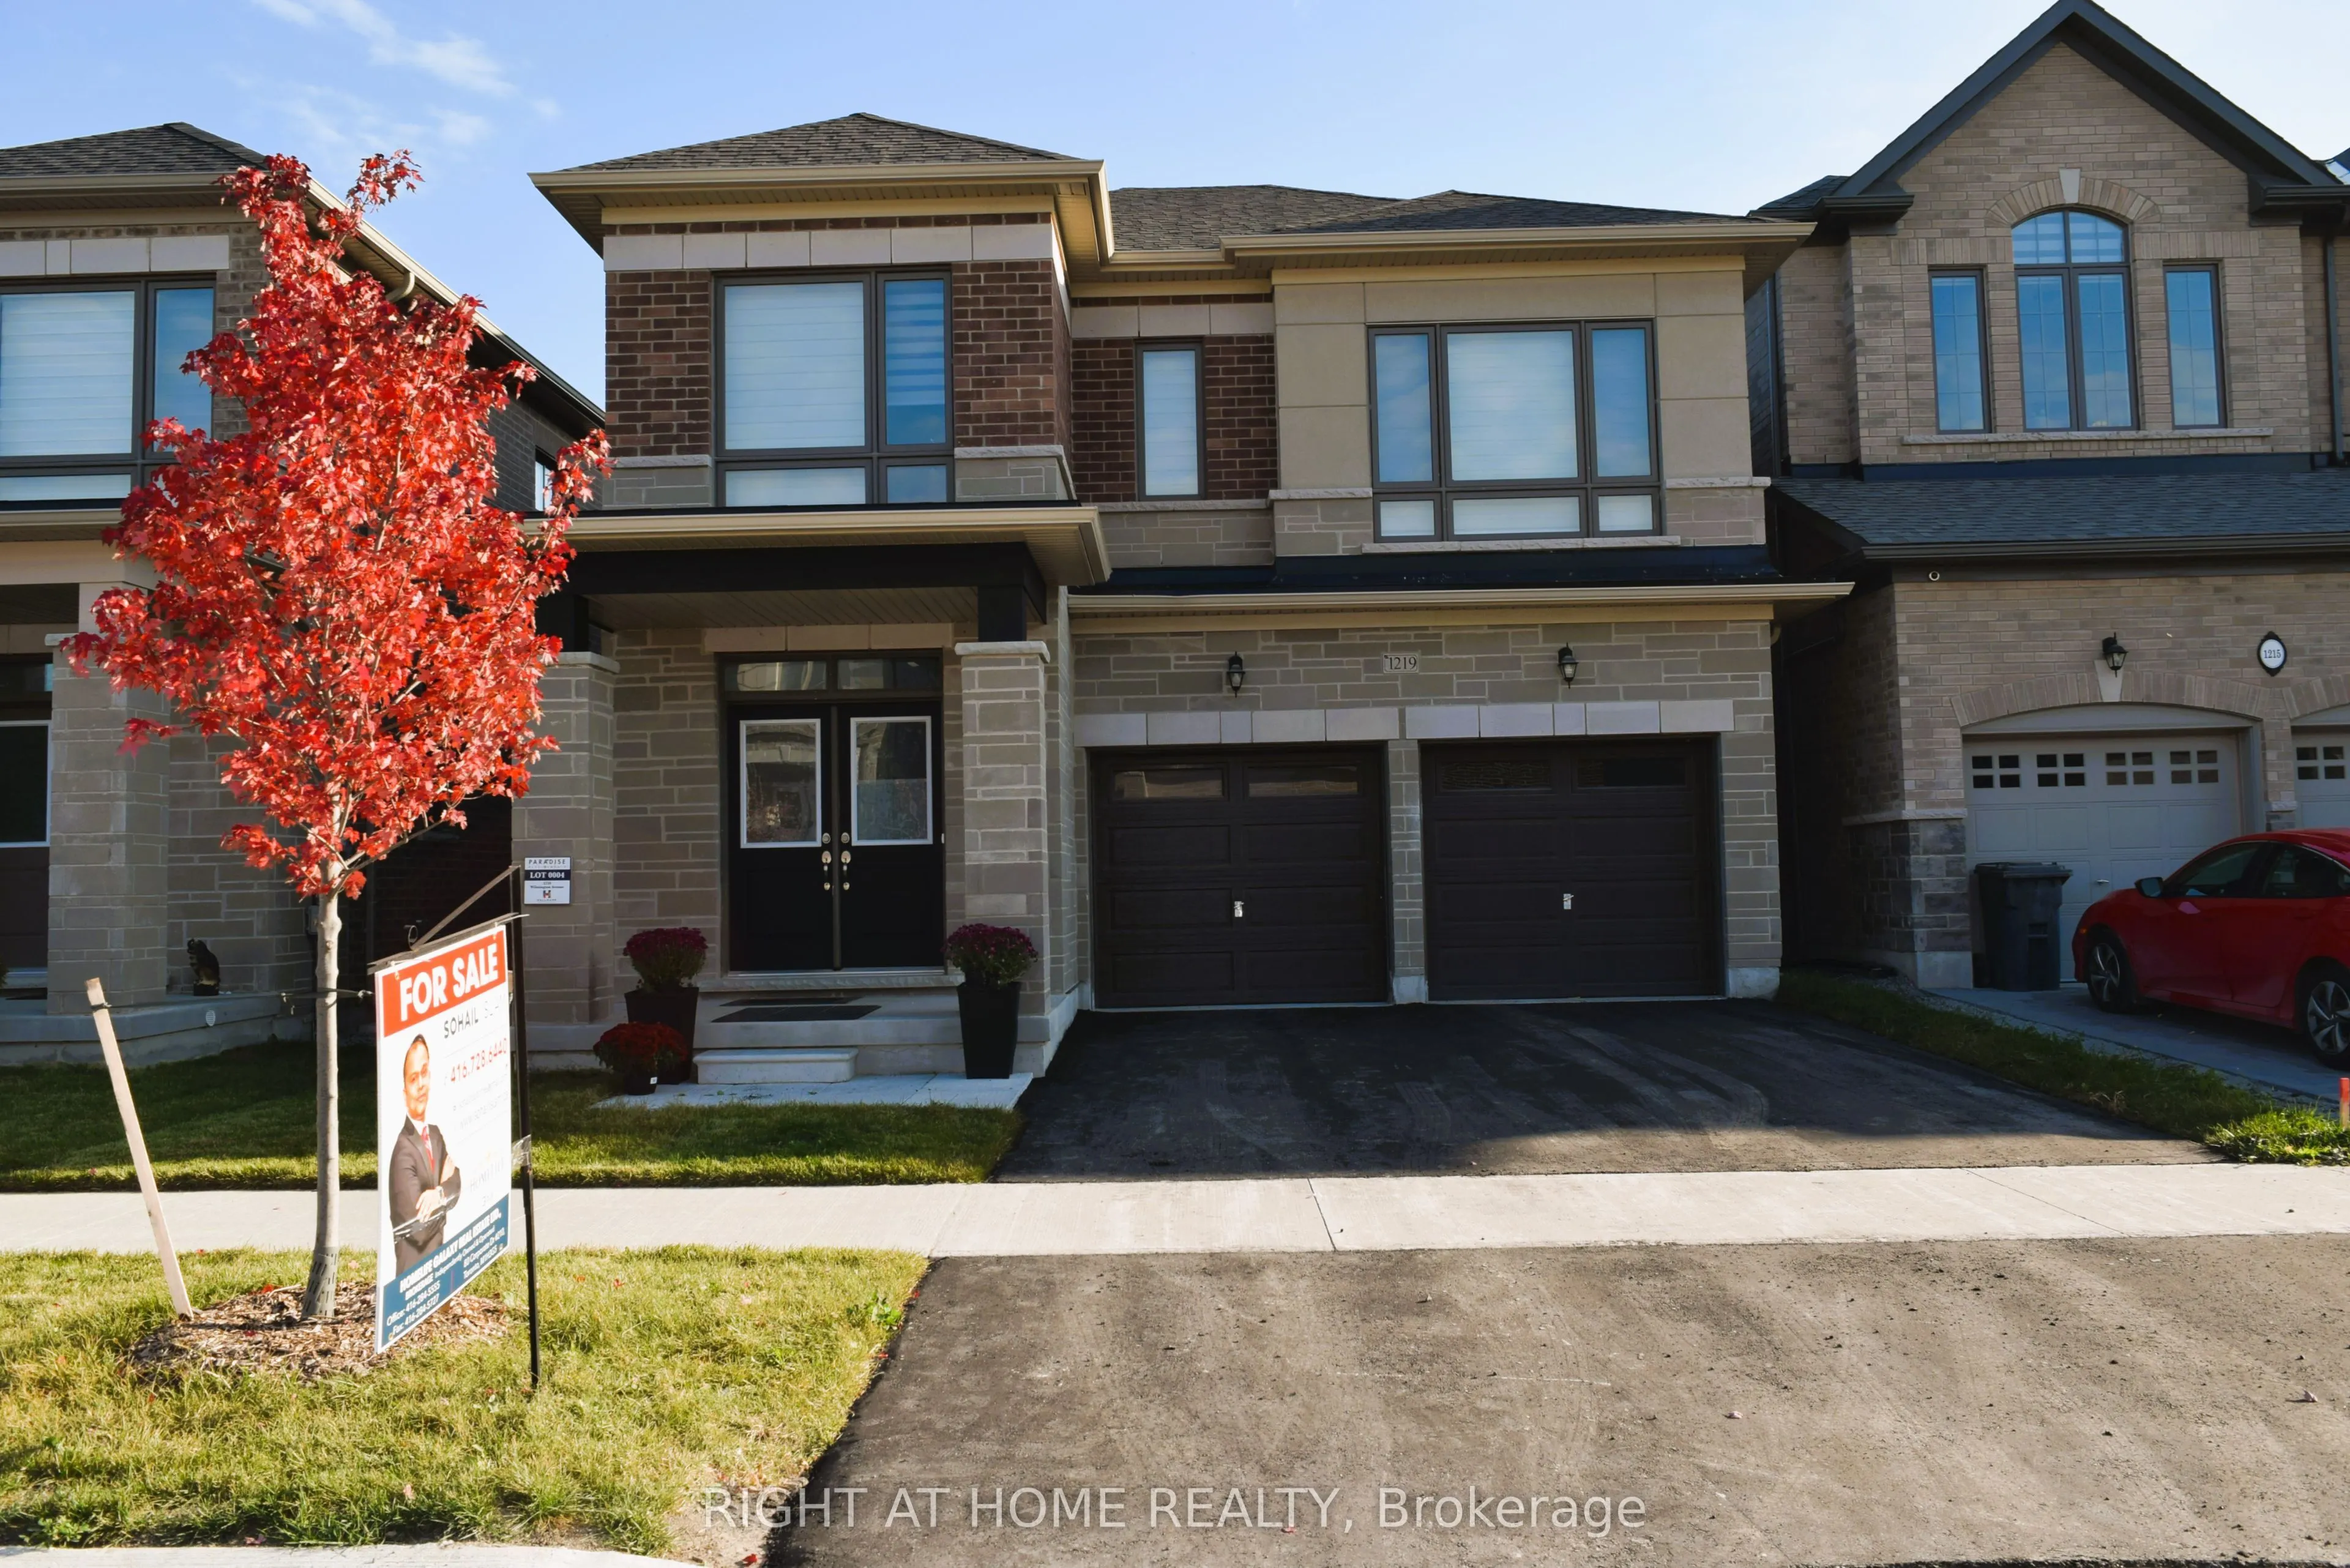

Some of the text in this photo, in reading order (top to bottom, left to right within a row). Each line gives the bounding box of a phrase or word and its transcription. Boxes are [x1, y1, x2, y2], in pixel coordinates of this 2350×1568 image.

[1390, 656, 1417, 670] 1219
[2263, 649, 2281, 659] 1215
[400, 965, 448, 1022] FOR
[452, 943, 498, 998] SALE
[444, 1007, 479, 1039] SOHAIL
[450, 1037, 507, 1083] 416.728.6440
[433, 1239, 458, 1268] GALAXY
